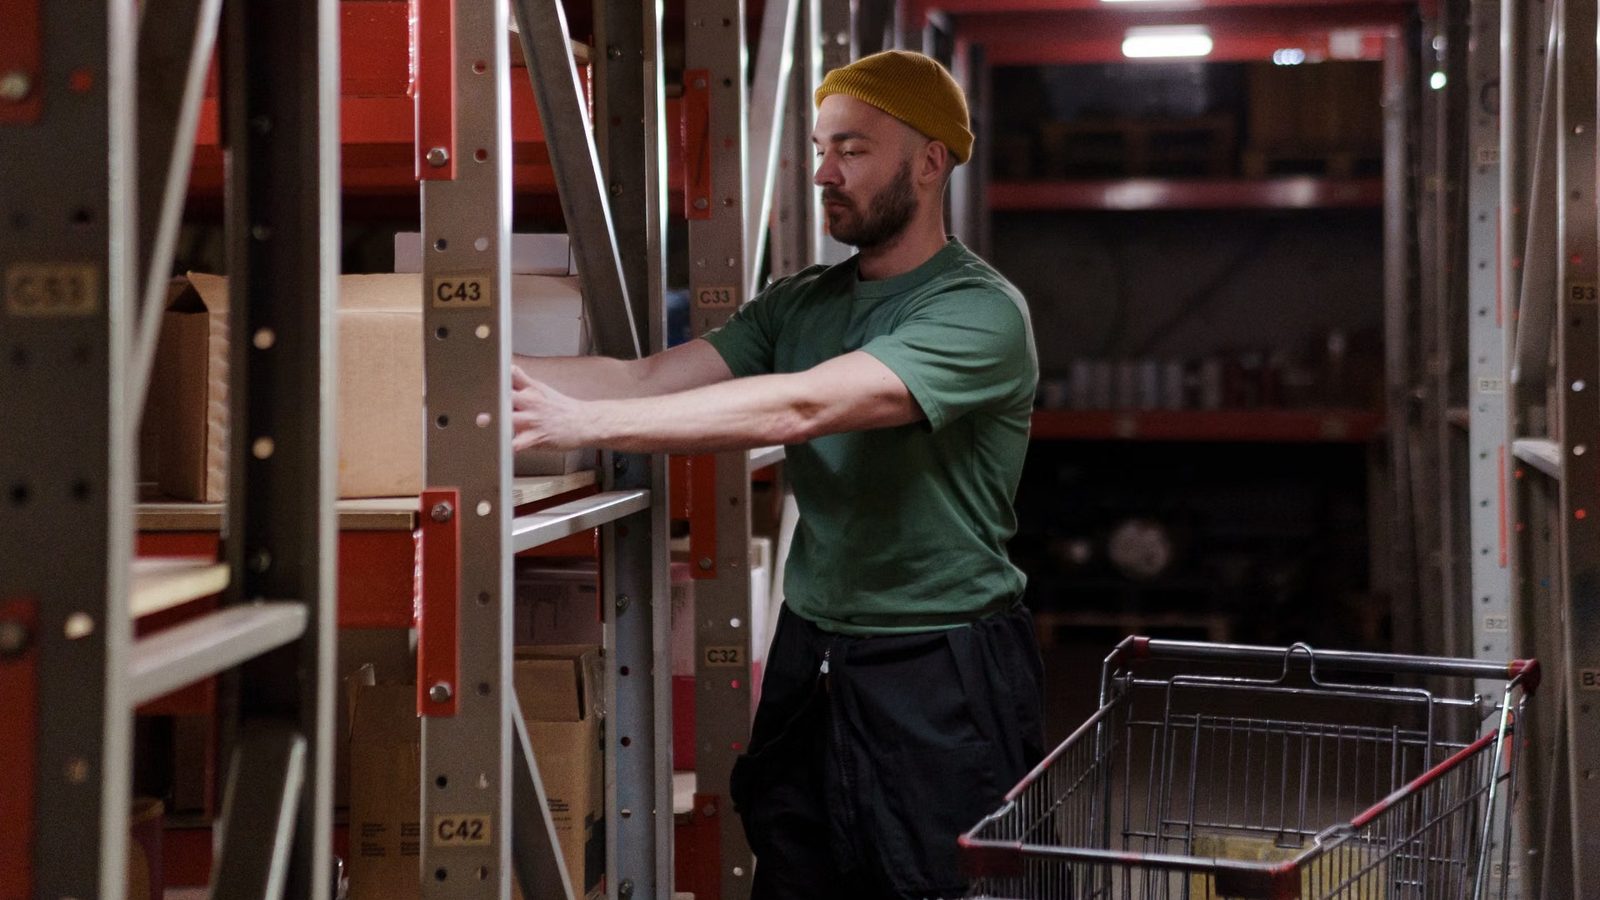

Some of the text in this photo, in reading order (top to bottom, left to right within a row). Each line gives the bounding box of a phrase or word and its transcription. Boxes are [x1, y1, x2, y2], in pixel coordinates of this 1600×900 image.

[437, 282, 481, 302] C43
[700, 290, 730, 304] C33
[707, 650, 737, 663] C32
[438, 819, 483, 840] C42
